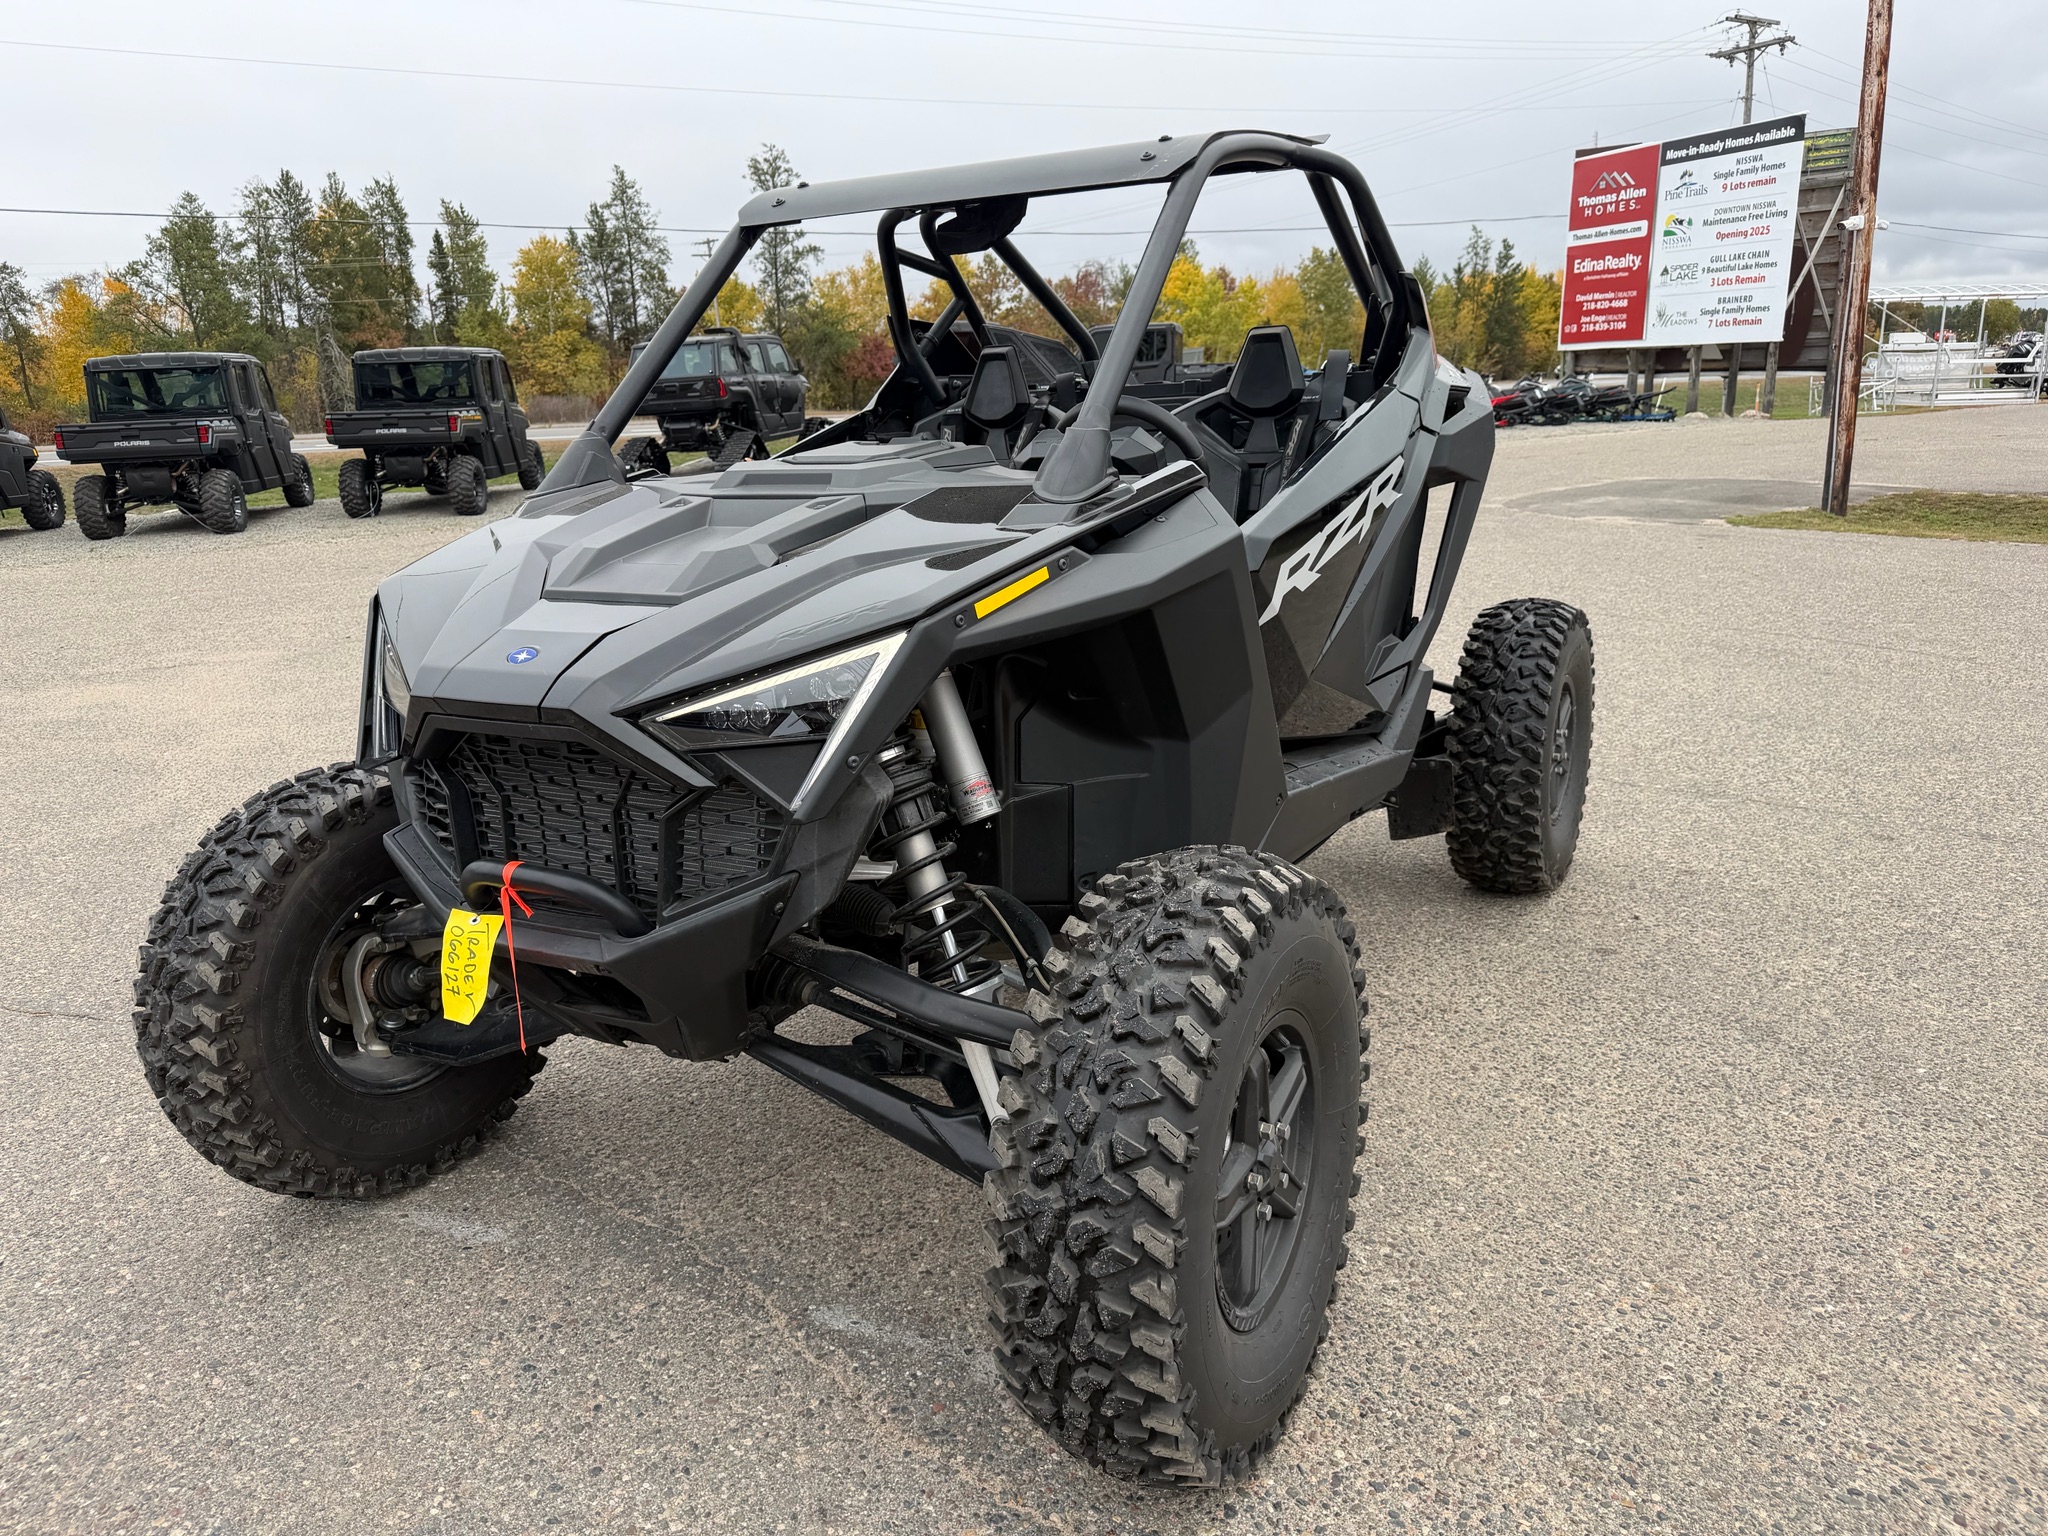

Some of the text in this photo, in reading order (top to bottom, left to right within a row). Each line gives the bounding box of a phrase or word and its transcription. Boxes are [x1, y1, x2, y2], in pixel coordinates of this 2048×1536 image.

[1666, 140, 1724, 160] Move-in-Ready
[1725, 135, 1754, 149] Homes
[1754, 126, 1796, 143] Available
[1736, 154, 1764, 166] NISSWA
[1713, 161, 1786, 181] Single Family Homes
[1722, 176, 1776, 193] 9 Lots remain
[1578, 188, 1647, 207] Thomas Allen
[1664, 185, 1708, 201] Pine Trails
[1584, 200, 1636, 217] HOMES
[1714, 200, 1777, 216] DOWNTOWN NISSWA
[1702, 209, 1788, 227] Maintenance Free Living
[1716, 225, 1771, 241] Opening 2025
[1662, 236, 1692, 246] NISSWA
[1710, 250, 1770, 263] GULL LAKE CHAIN
[1670, 263, 1699, 272] SPIDER
[1707, 263, 1736, 274] Beautiful
[1737, 262, 1753, 271] Lake
[1754, 261, 1778, 269] Homes
[1669, 270, 1698, 281] LAKE
[1710, 278, 1715, 287] 3
[1716, 277, 1733, 286] Lots
[1735, 273, 1766, 285] Remain
[1576, 292, 1593, 302] David
[1718, 295, 1753, 305] BRAINERD
[1700, 304, 1770, 317] Single Family Homes
[1580, 315, 1590, 323] Joe
[1708, 316, 1762, 328] 7 Lots Remain
[1258, 454, 1405, 626] RZR
